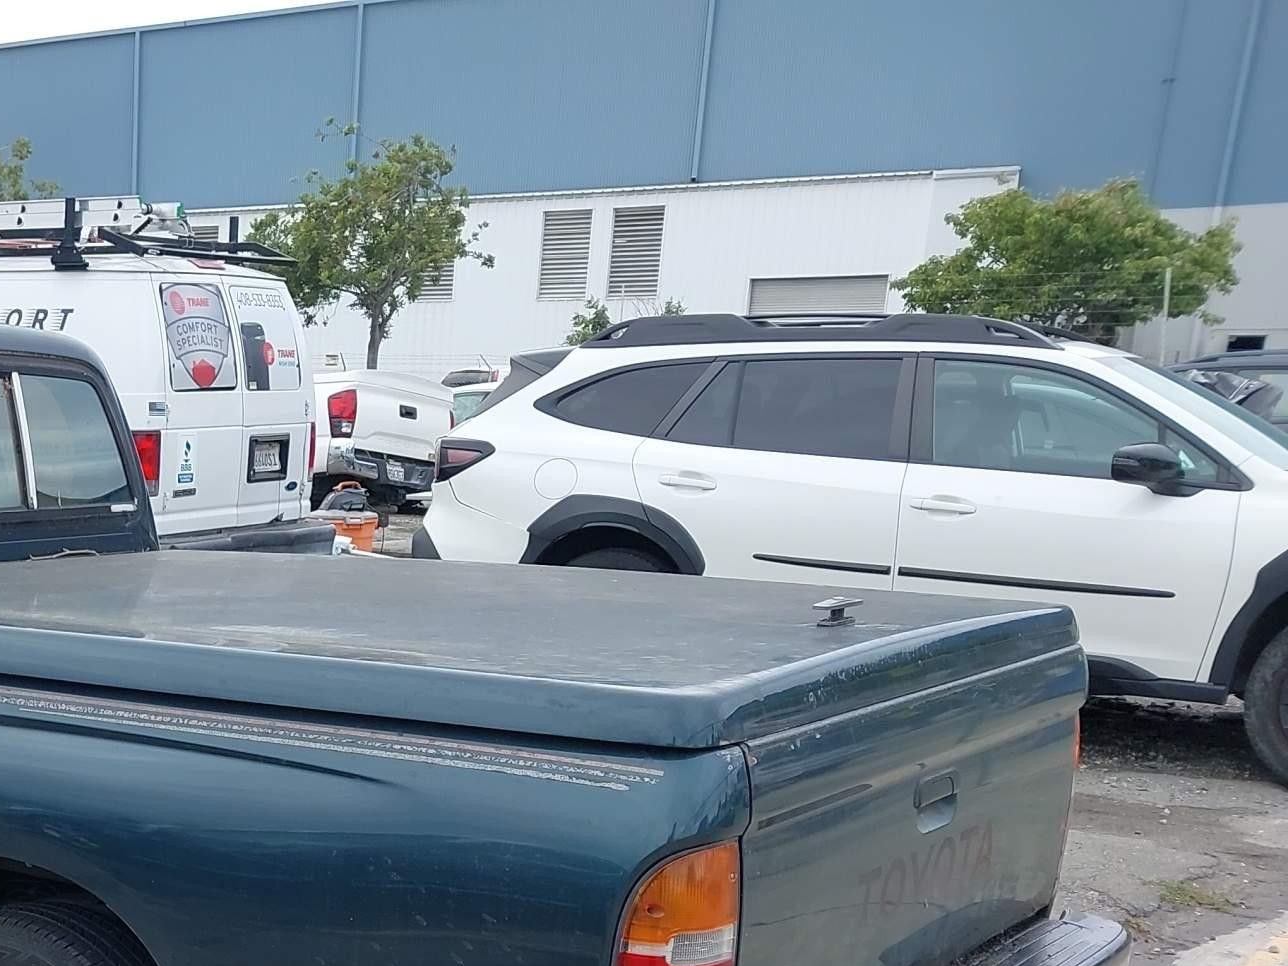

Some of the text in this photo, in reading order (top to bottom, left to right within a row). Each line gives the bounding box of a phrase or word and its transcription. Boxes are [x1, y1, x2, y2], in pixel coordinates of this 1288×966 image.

[176, 322, 218, 336] COMFORT
[176, 336, 225, 351] SPECIALIST
[859, 818, 993, 922] TOYOTA
